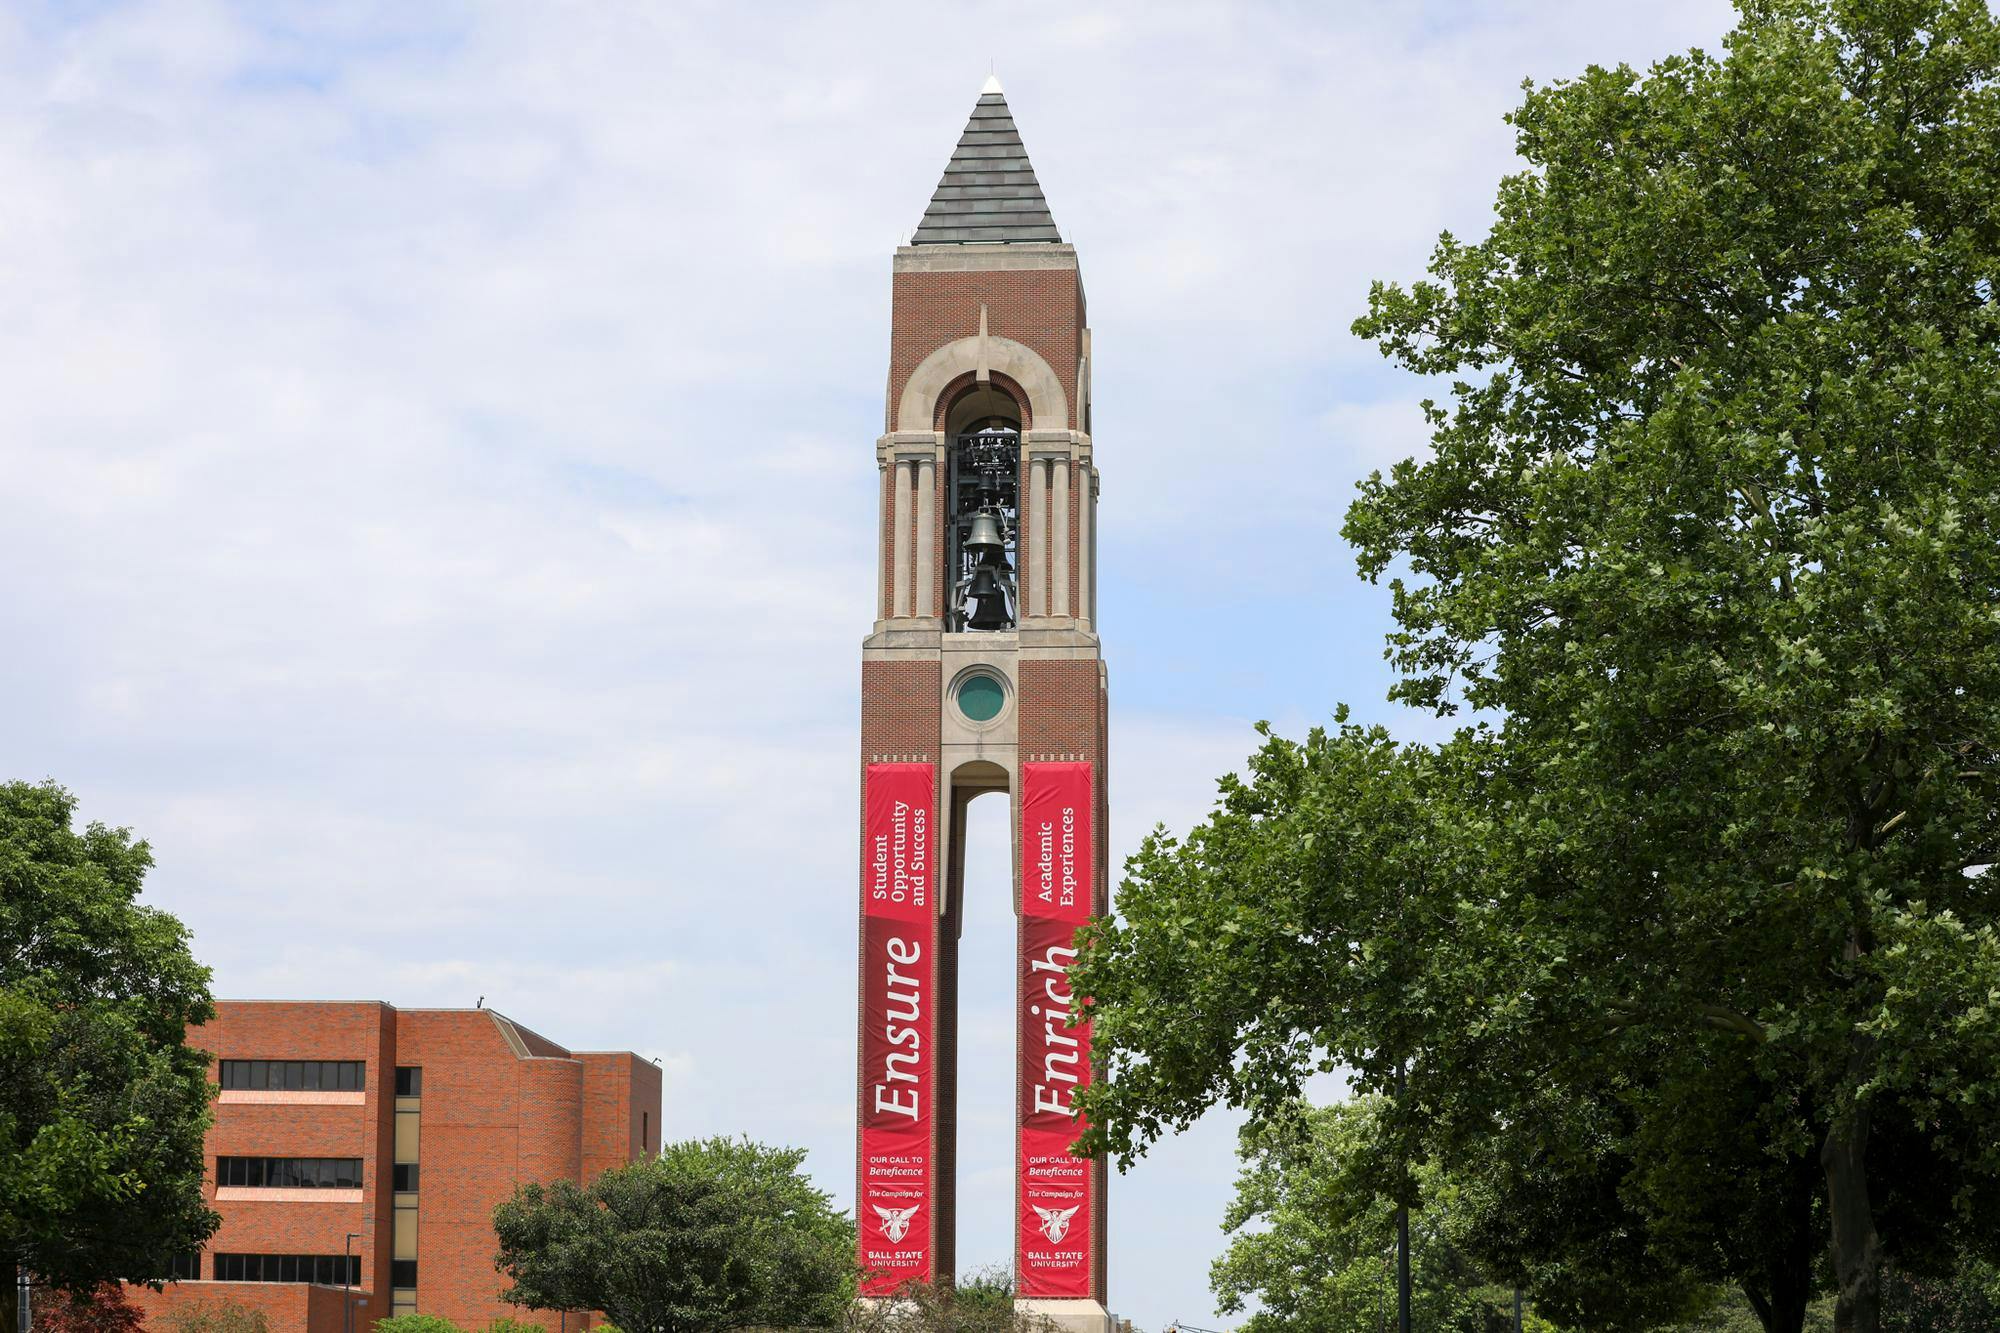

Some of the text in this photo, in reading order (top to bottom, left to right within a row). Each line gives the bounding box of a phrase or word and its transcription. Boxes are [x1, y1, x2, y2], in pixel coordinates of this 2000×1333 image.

[891, 800, 909, 903] Opportunity
[910, 808, 926, 907] and Success
[1060, 807, 1077, 907] Experiences
[873, 834, 888, 900] Student
[1037, 822, 1053, 903] Academic
[875, 936, 921, 1122] Ensure
[1031, 945, 1079, 1117] Enrich
[870, 1156, 923, 1164] OUR CALL TO
[1029, 1156, 1083, 1164] OUR CALL TO
[869, 1167, 923, 1177] Beneficence
[1029, 1167, 1083, 1177] Beneficence
[869, 1190, 924, 1199] The Campaign for
[1028, 1190, 1084, 1199] The Campaign for
[868, 1251, 923, 1259] BALL STATE
[1028, 1252, 1083, 1260] BALL STATE
